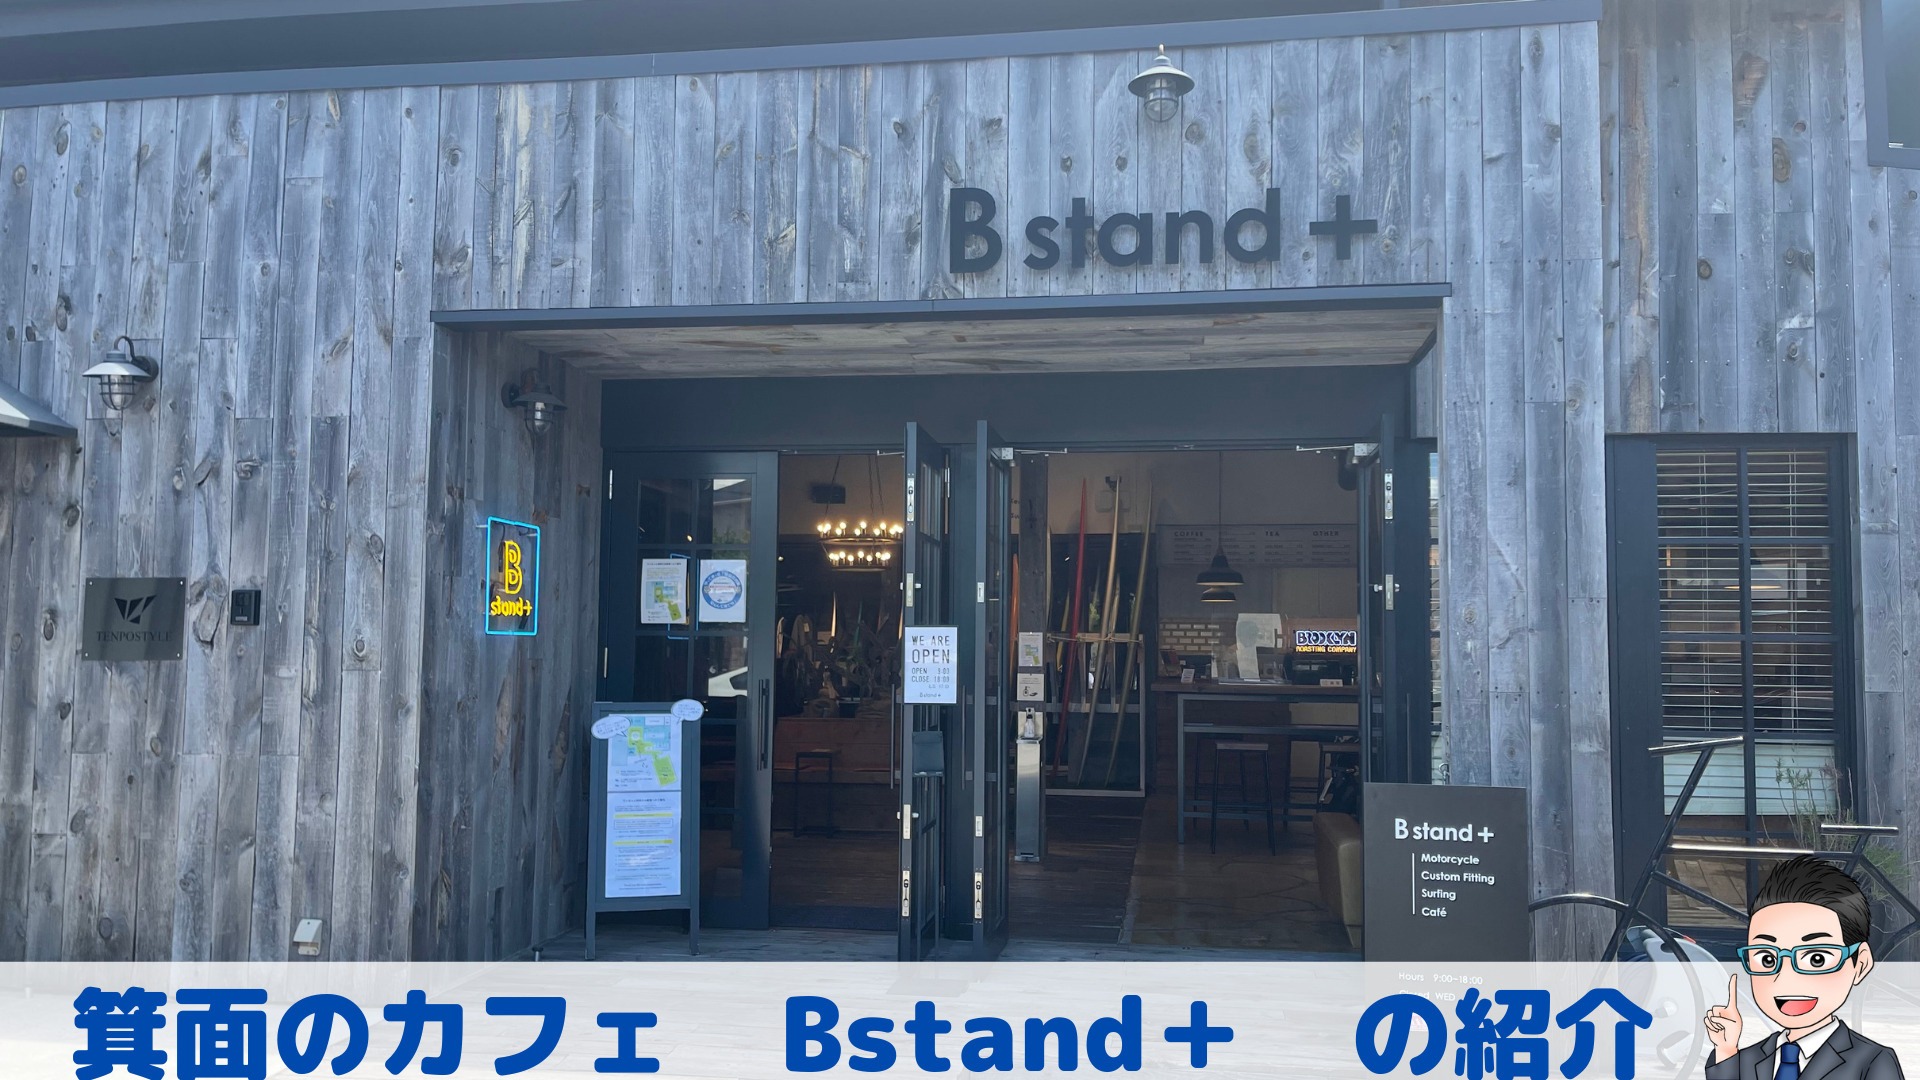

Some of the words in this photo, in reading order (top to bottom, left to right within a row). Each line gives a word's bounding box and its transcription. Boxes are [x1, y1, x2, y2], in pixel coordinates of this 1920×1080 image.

[949, 187, 1002, 274] B
[1023, 187, 1281, 271] stand
[504, 540, 523, 594] B
[97, 631, 173, 642] TENPOSTYLE
[912, 635, 925, 646] WE
[931, 635, 950, 646] ARE
[1296, 631, 1357, 645] BROOKLYN
[912, 649, 950, 664] OPEN
[911, 675, 930, 683] CLOSE
[1394, 817, 1409, 840] B
[1412, 822, 1473, 842] stand
[1421, 853, 1480, 866] Motorcycle
[1421, 870, 1460, 882] Custom
[1463, 872, 1495, 885] Fitting
[1421, 888, 1457, 901] Surfing
[1421, 906, 1448, 918] Café
[1398, 972, 1425, 982] Hours
[1435, 992, 1456, 1001] WED
